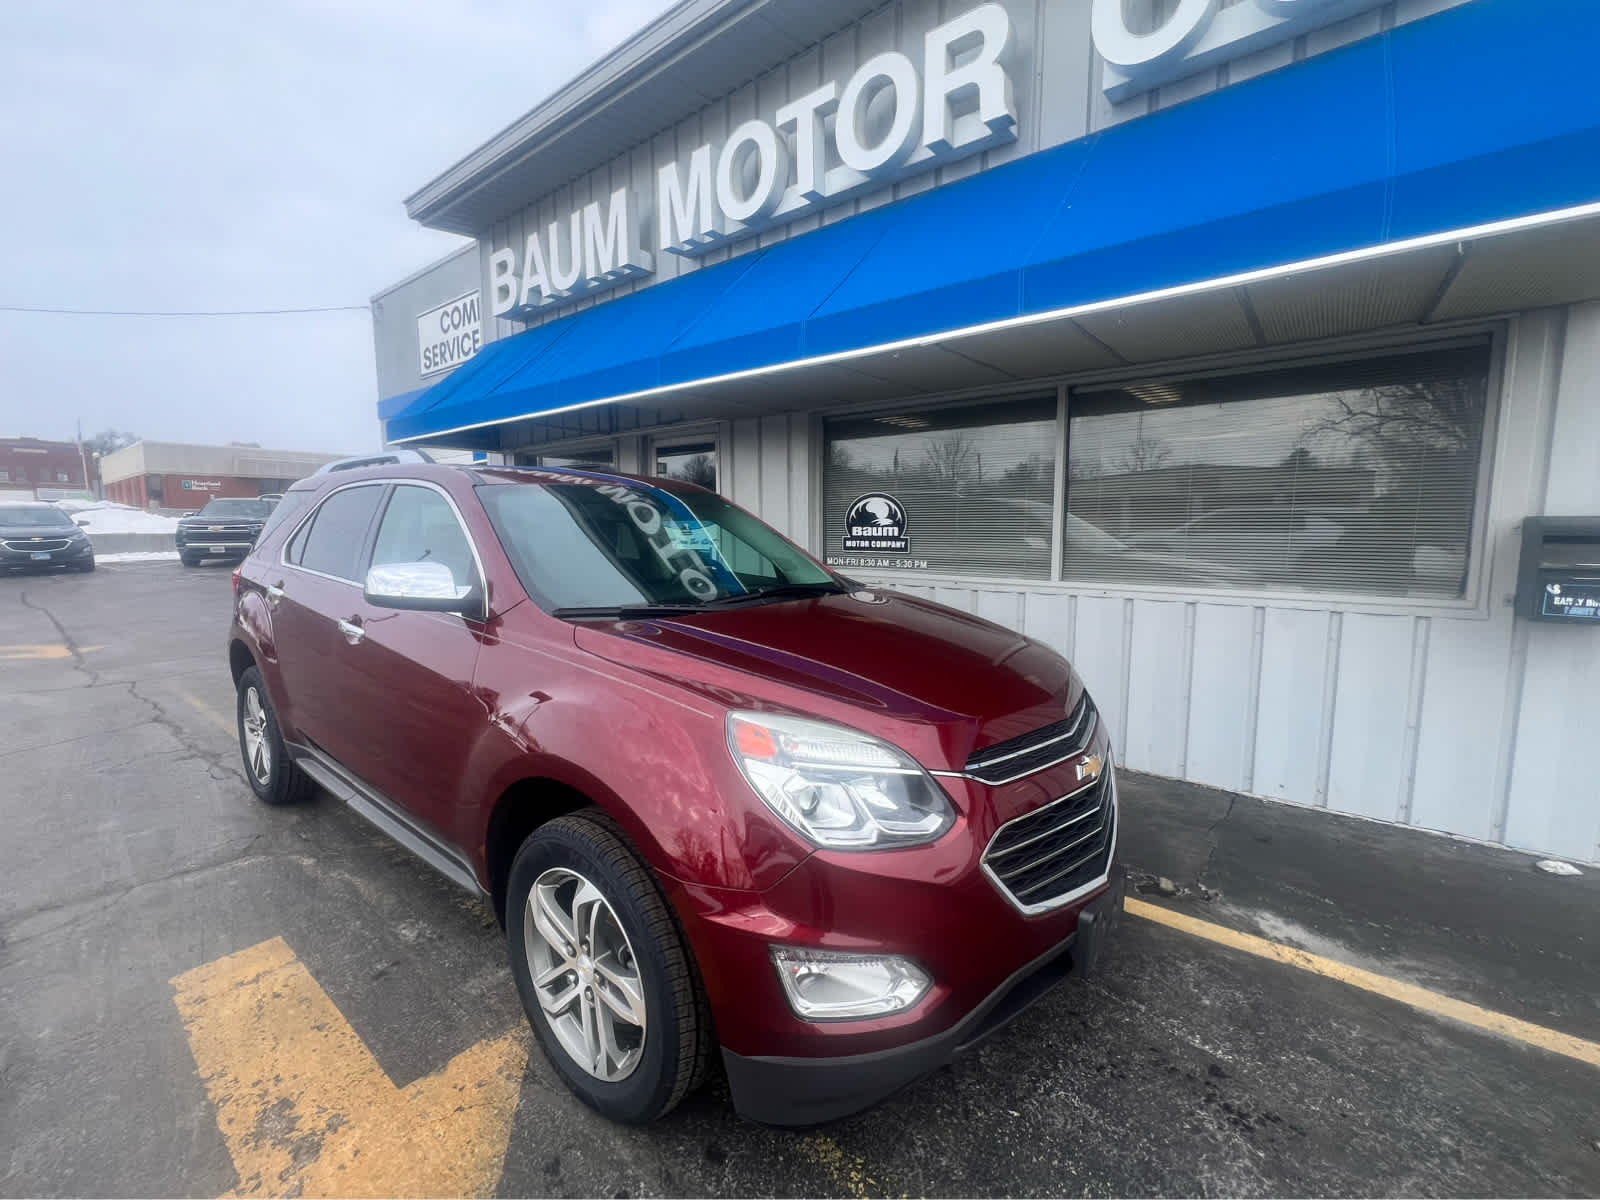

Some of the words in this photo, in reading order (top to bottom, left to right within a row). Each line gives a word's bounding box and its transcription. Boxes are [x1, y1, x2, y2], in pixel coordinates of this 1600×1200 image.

[490, 186, 632, 317] BAUM
[657, 2, 1013, 251] MOTOR
[440, 296, 480, 335] COM
[423, 329, 480, 371] SERVICE
[826, 556, 859, 566] MON-FRI
[860, 558, 875, 567] 8:30
[876, 559, 890, 567] AM
[895, 559, 912, 568] 5:30
[914, 560, 928, 569] PM
[845, 540, 870, 548] MOTOR
[871, 540, 906, 549] COMPANY
